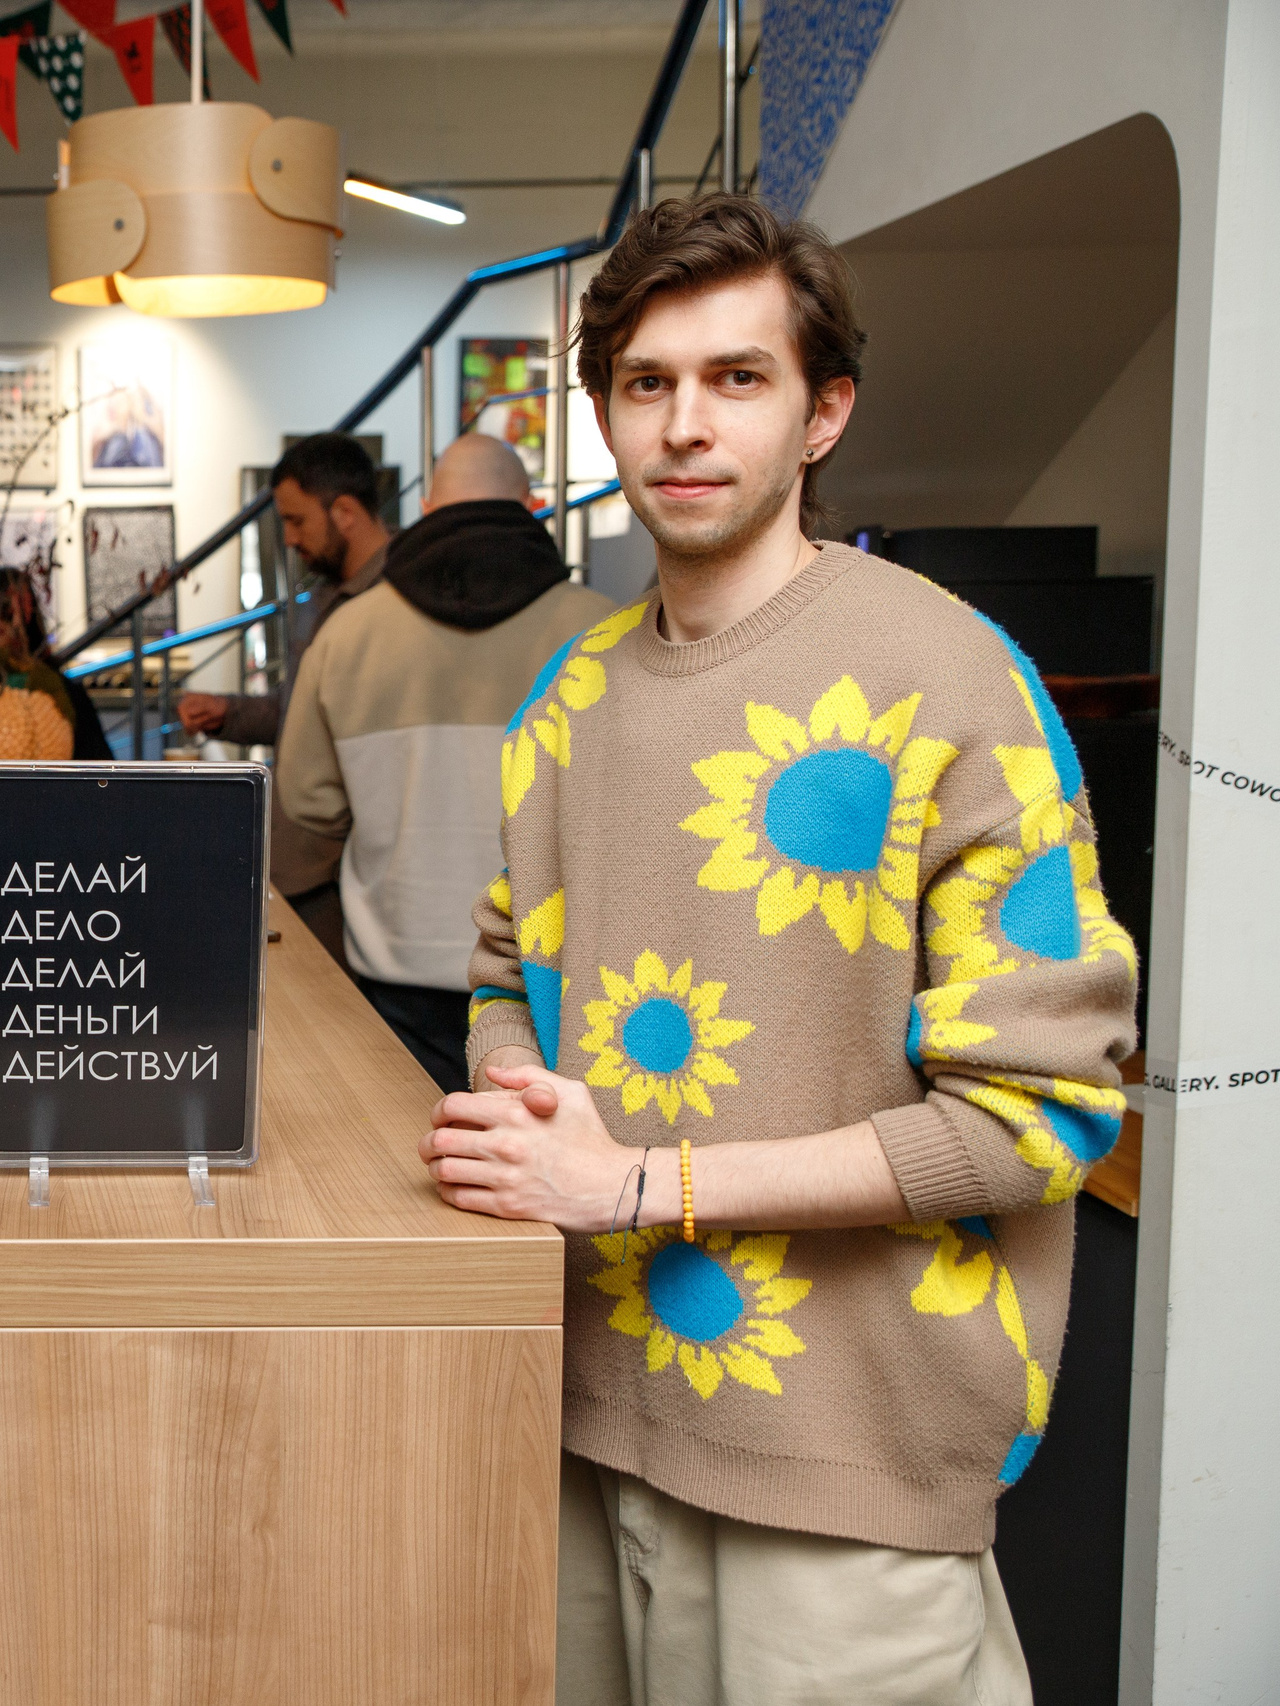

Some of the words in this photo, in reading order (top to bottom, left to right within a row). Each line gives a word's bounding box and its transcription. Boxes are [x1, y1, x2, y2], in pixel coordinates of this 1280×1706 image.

[1, 855, 147, 897] ДЕЛАЙ
[1, 910, 121, 945] ДЕЛО
[1, 951, 146, 991] ДЕЛАЙ
[2, 1004, 158, 1038] ДЕНЬГИ
[2, 1044, 218, 1084] ДЕЙСТВУЙ
[1228, 1068, 1280, 1088] SPOT
